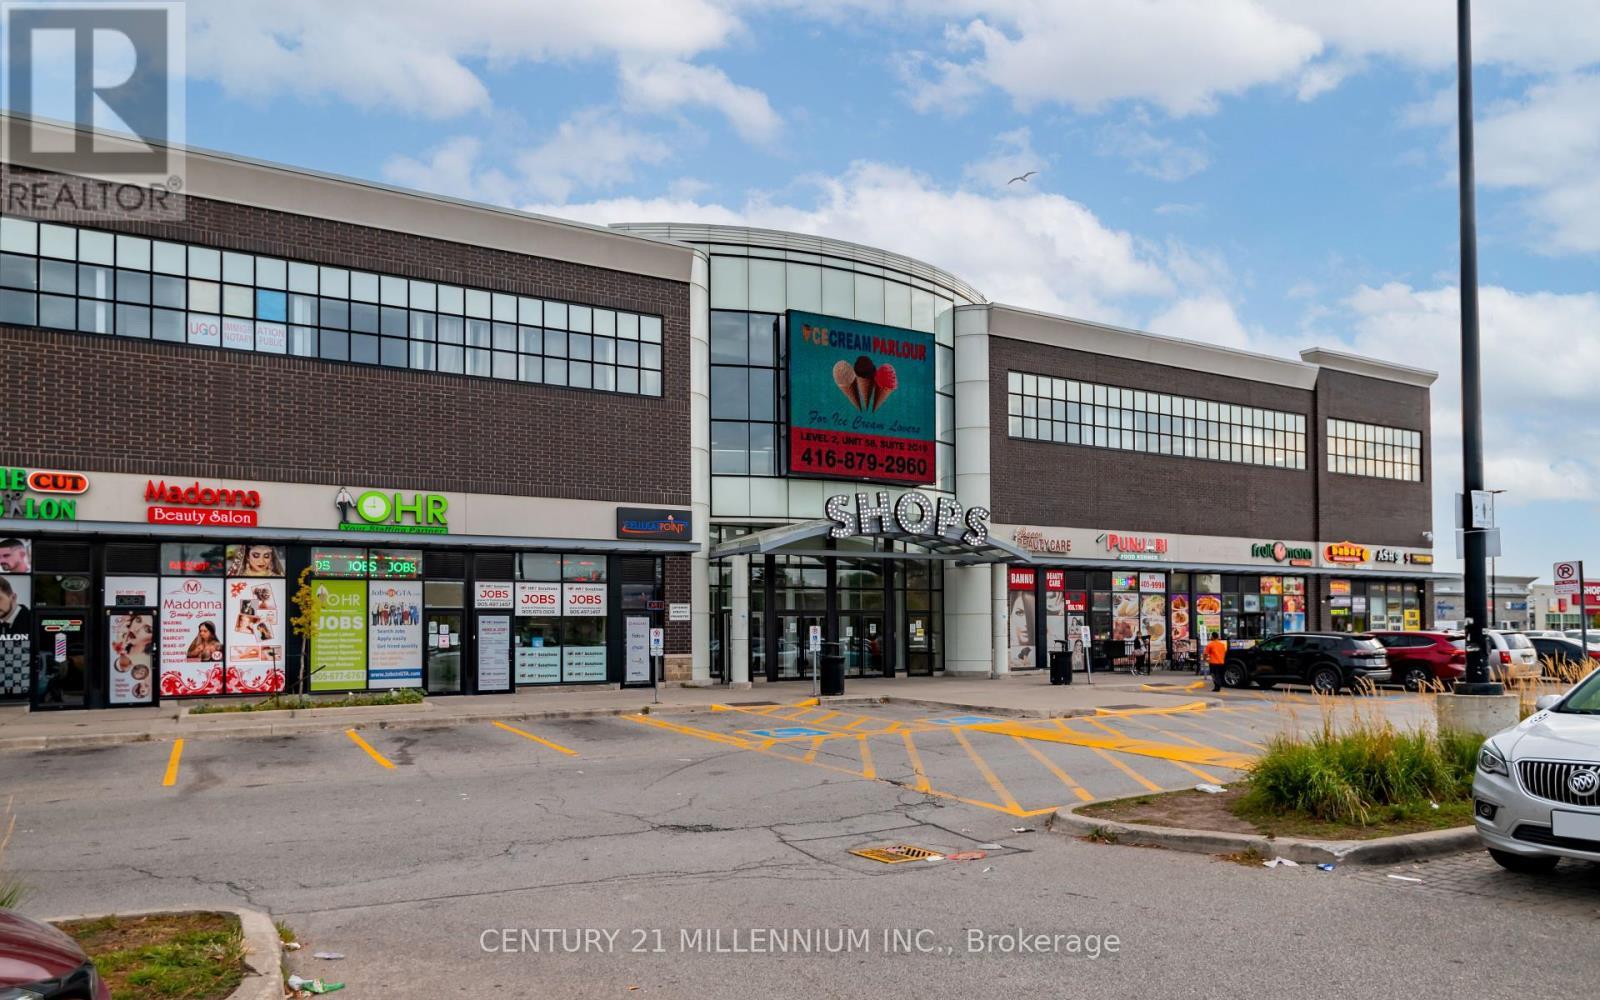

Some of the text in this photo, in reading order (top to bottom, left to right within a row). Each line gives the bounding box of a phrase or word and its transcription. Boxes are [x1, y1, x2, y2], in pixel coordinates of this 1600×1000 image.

[190, 322, 218, 336] UGO
[808, 410, 921, 434] For Ice Cream Lovers
[800, 432, 828, 443] LEVEL
[842, 437, 862, 446] UNIT
[880, 440, 905, 450] SUITE
[801, 447, 928, 475] 416-879-2960
[34, 474, 84, 490] CUT
[145, 479, 260, 508] Madonna
[356, 490, 448, 525] OHR
[154, 508, 251, 525] Beauty Salon
[825, 491, 990, 546] SHOPS
[659, 521, 685, 533] POINT
[1050, 539, 1072, 551] CARE
[1107, 534, 1168, 552] PUNJABI
[388, 561, 416, 573] JOBS
[1011, 573, 1034, 584] BANNU
[1046, 572, 1064, 580] BEAUTY
[480, 590, 509, 598] JOBS
[521, 594, 556, 604] JOBS
[569, 595, 602, 604] JOBS
[163, 598, 222, 609] Madonna
